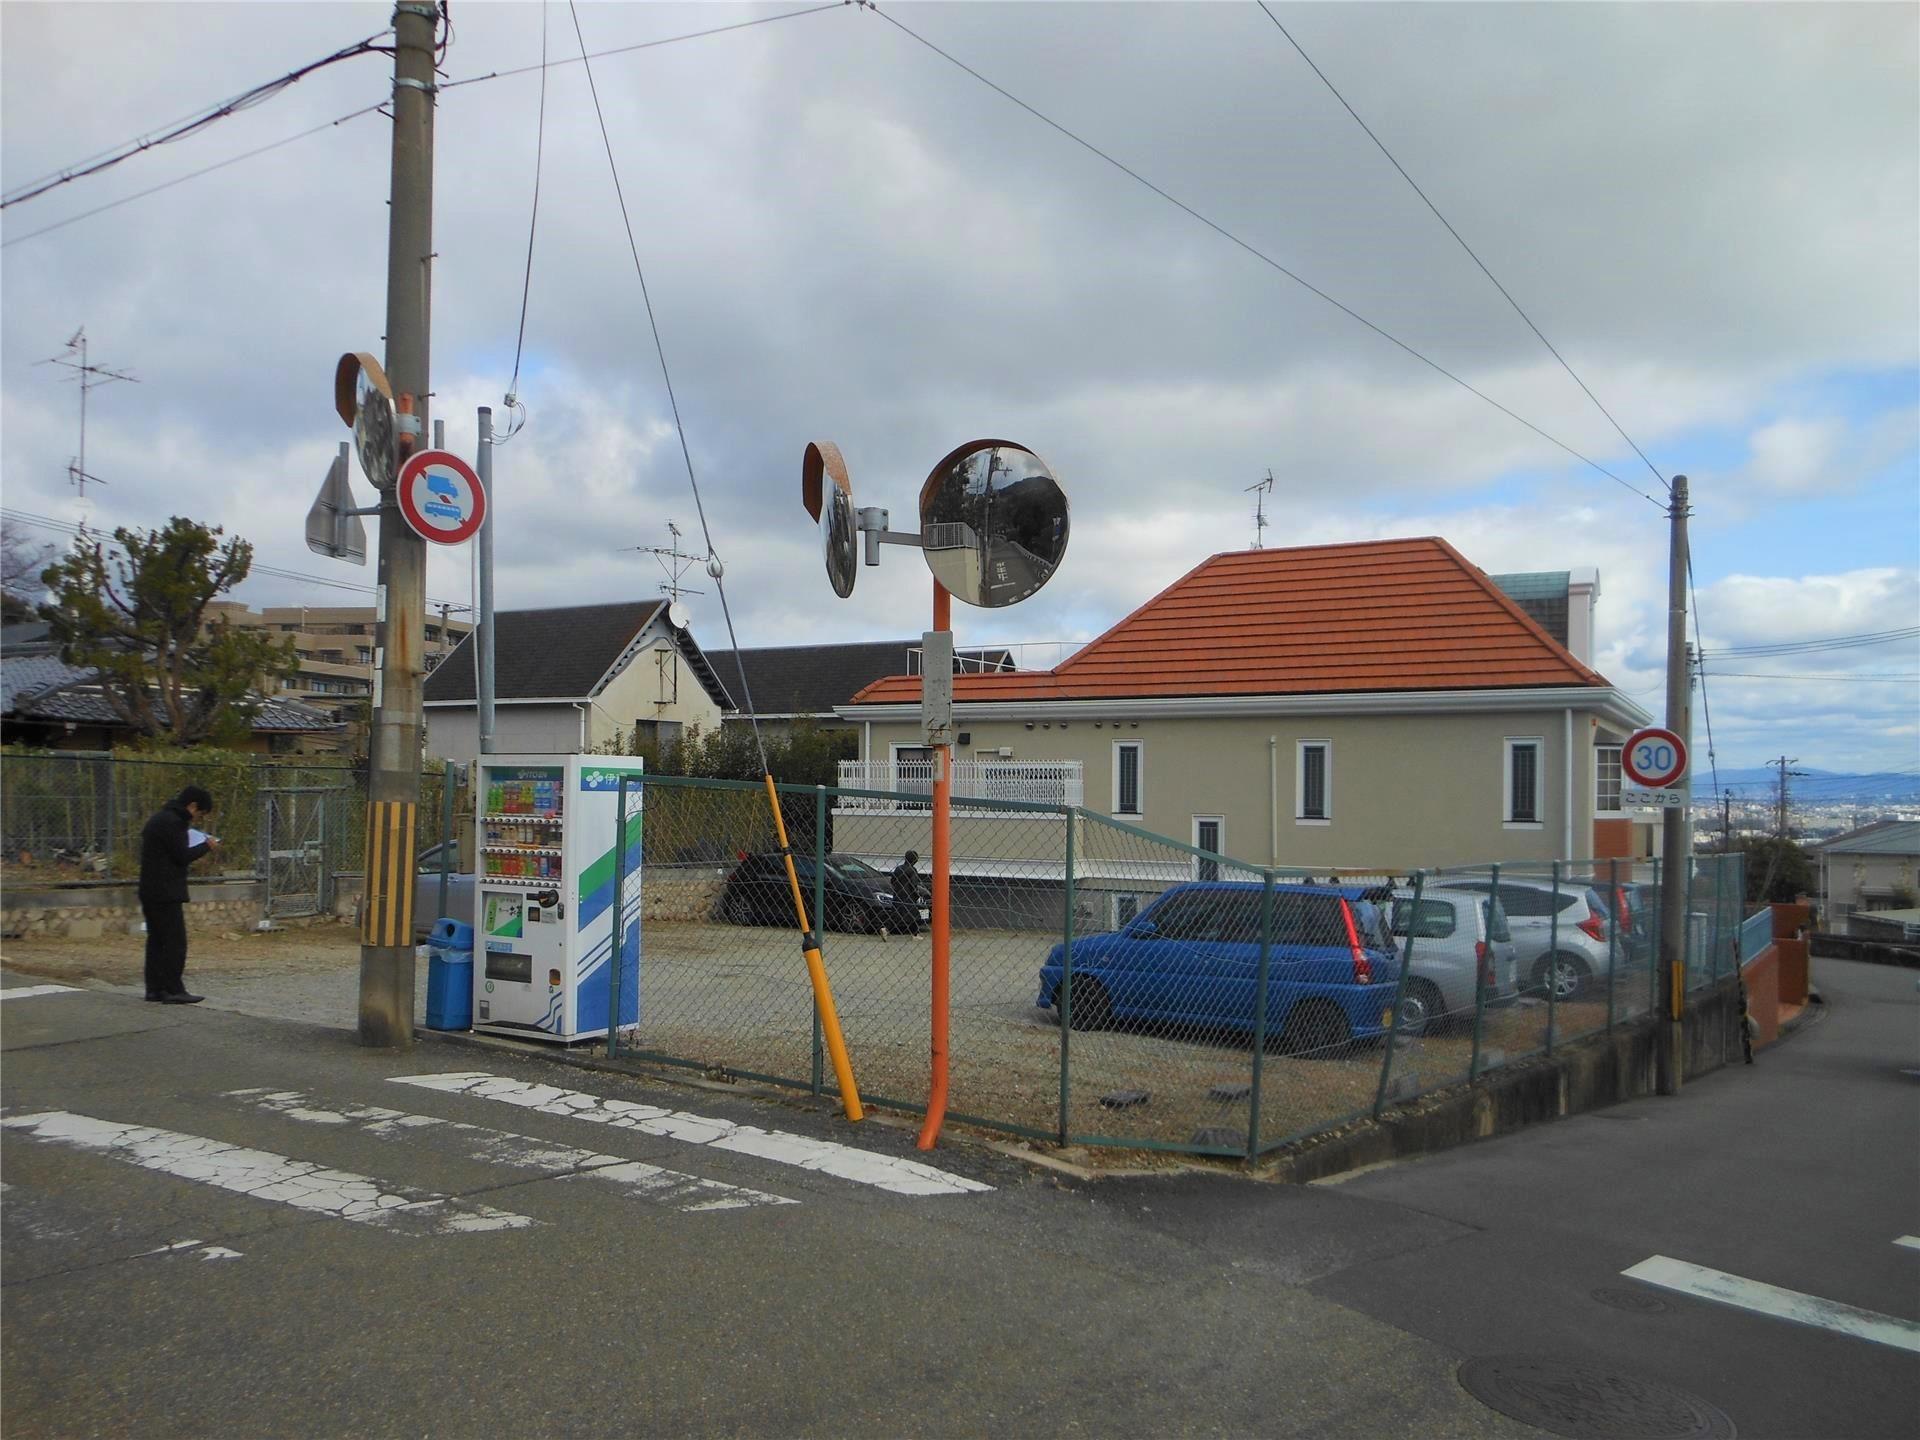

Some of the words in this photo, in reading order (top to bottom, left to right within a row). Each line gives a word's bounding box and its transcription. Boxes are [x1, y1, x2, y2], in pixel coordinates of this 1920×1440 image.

[1636, 745, 1671, 770] 30
[1625, 793, 1680, 804] ここから
